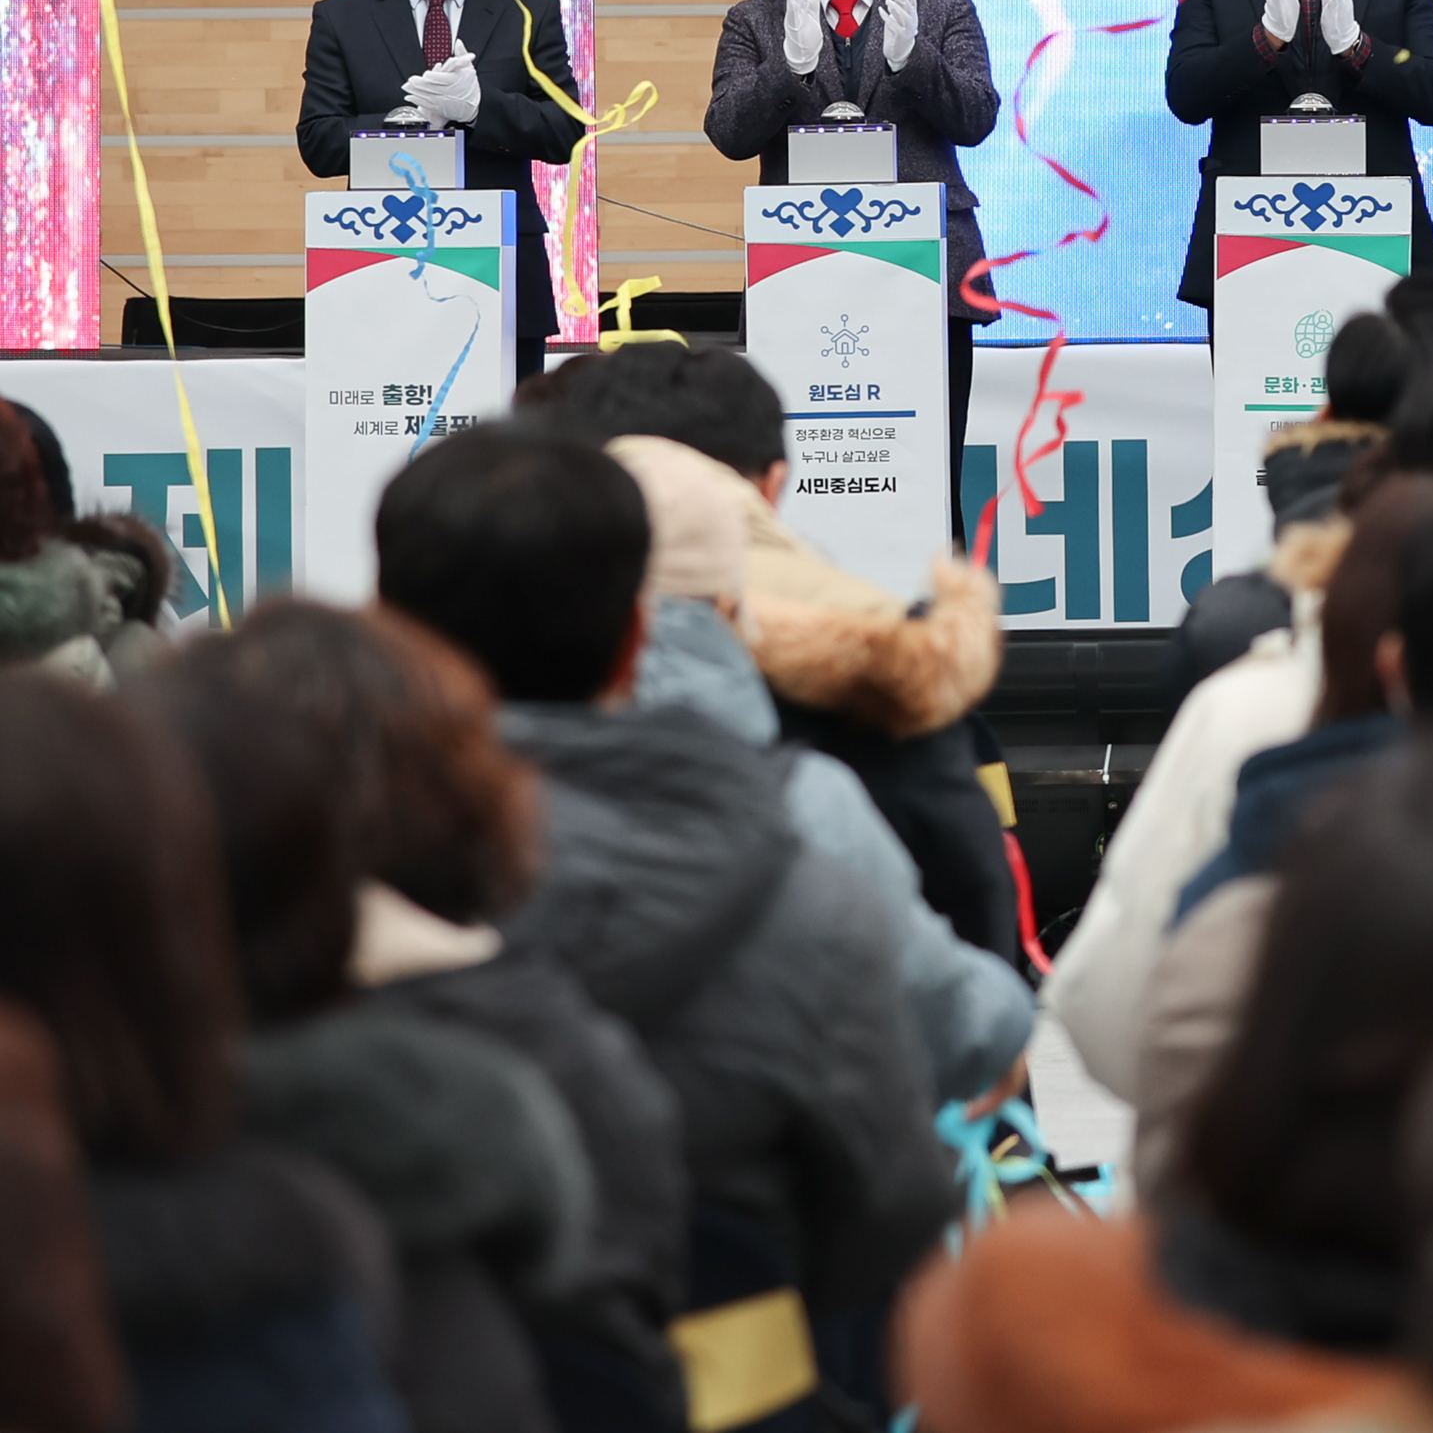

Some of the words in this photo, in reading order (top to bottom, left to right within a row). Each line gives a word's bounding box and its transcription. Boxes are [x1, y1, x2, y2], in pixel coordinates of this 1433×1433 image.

[808, 384, 861, 402] 원도심
[867, 384, 881, 401] R
[1264, 376, 1327, 394] 문화·관
[329, 390, 375, 406] 미래로
[382, 384, 433, 406] 출항!
[353, 421, 399, 436] 세계로
[795, 428, 844, 442] 정주환경
[847, 427, 896, 441] 혁신으로
[801, 450, 838, 464] 누구나
[842, 449, 890, 463] 살고싶은
[796, 476, 897, 495] 시민중심도시
